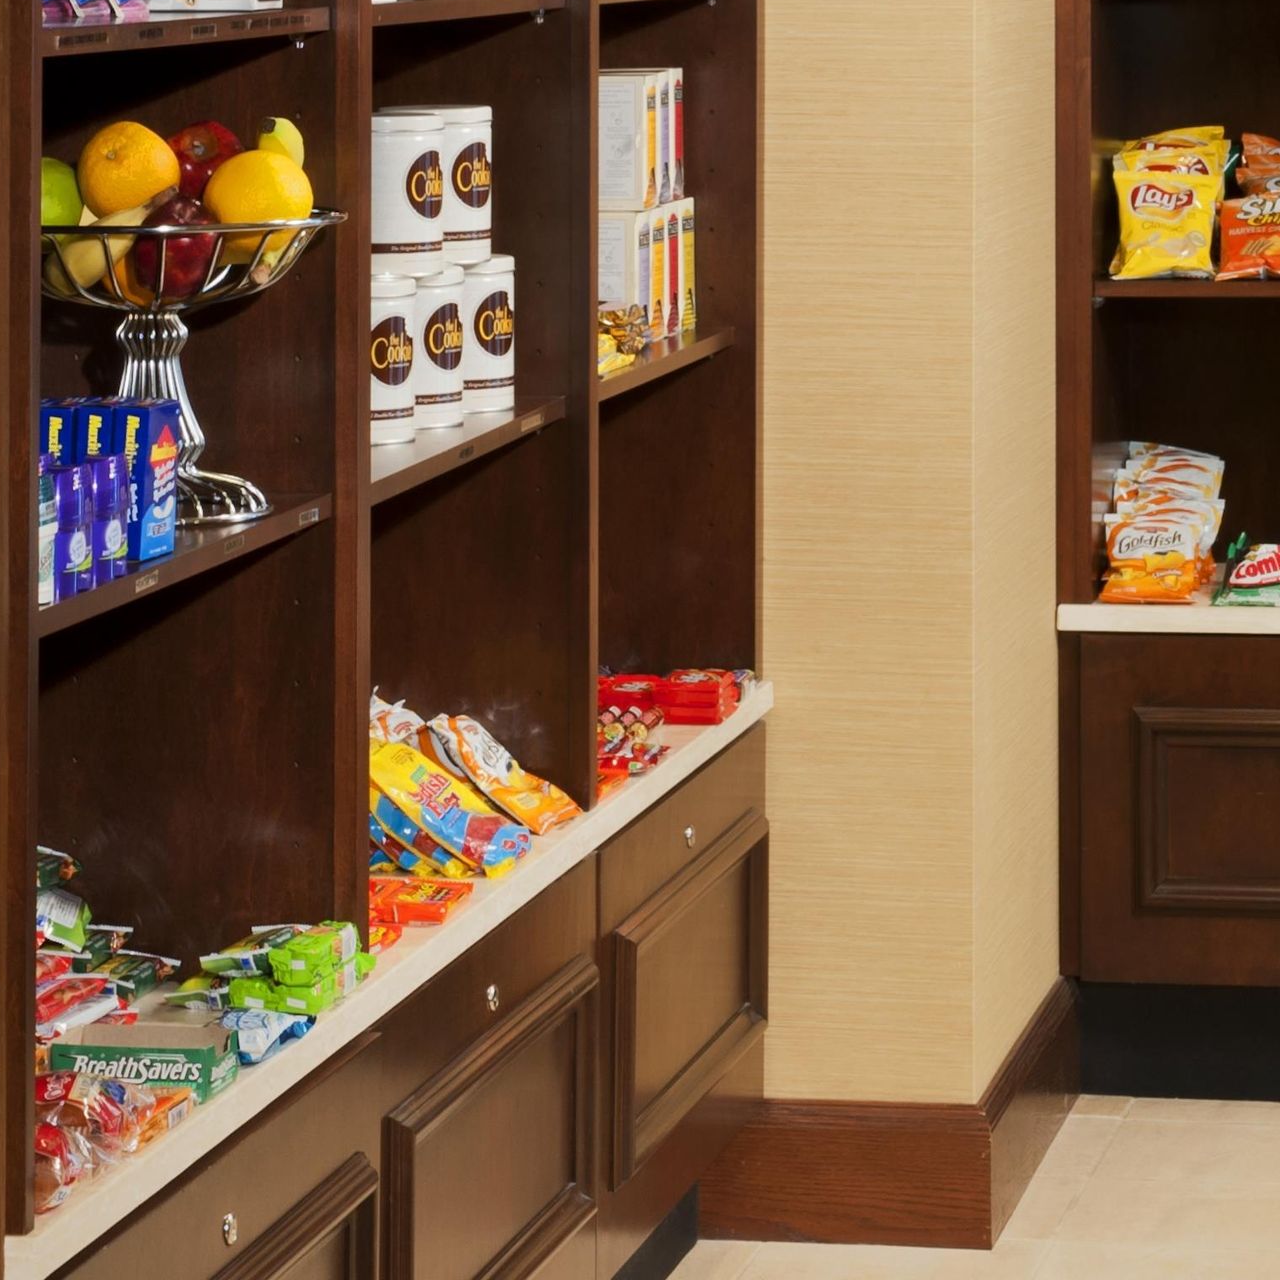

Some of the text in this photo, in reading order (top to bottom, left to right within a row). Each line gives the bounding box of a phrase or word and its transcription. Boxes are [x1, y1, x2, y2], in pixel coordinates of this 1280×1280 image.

[411, 166, 443, 202] Cook
[456, 158, 492, 193] Cooki
[429, 320, 463, 355] Cooki
[479, 306, 513, 341] Cooki
[1119, 530, 1182, 553] Goldfish
[73, 1054, 203, 1084] BreathSavers
